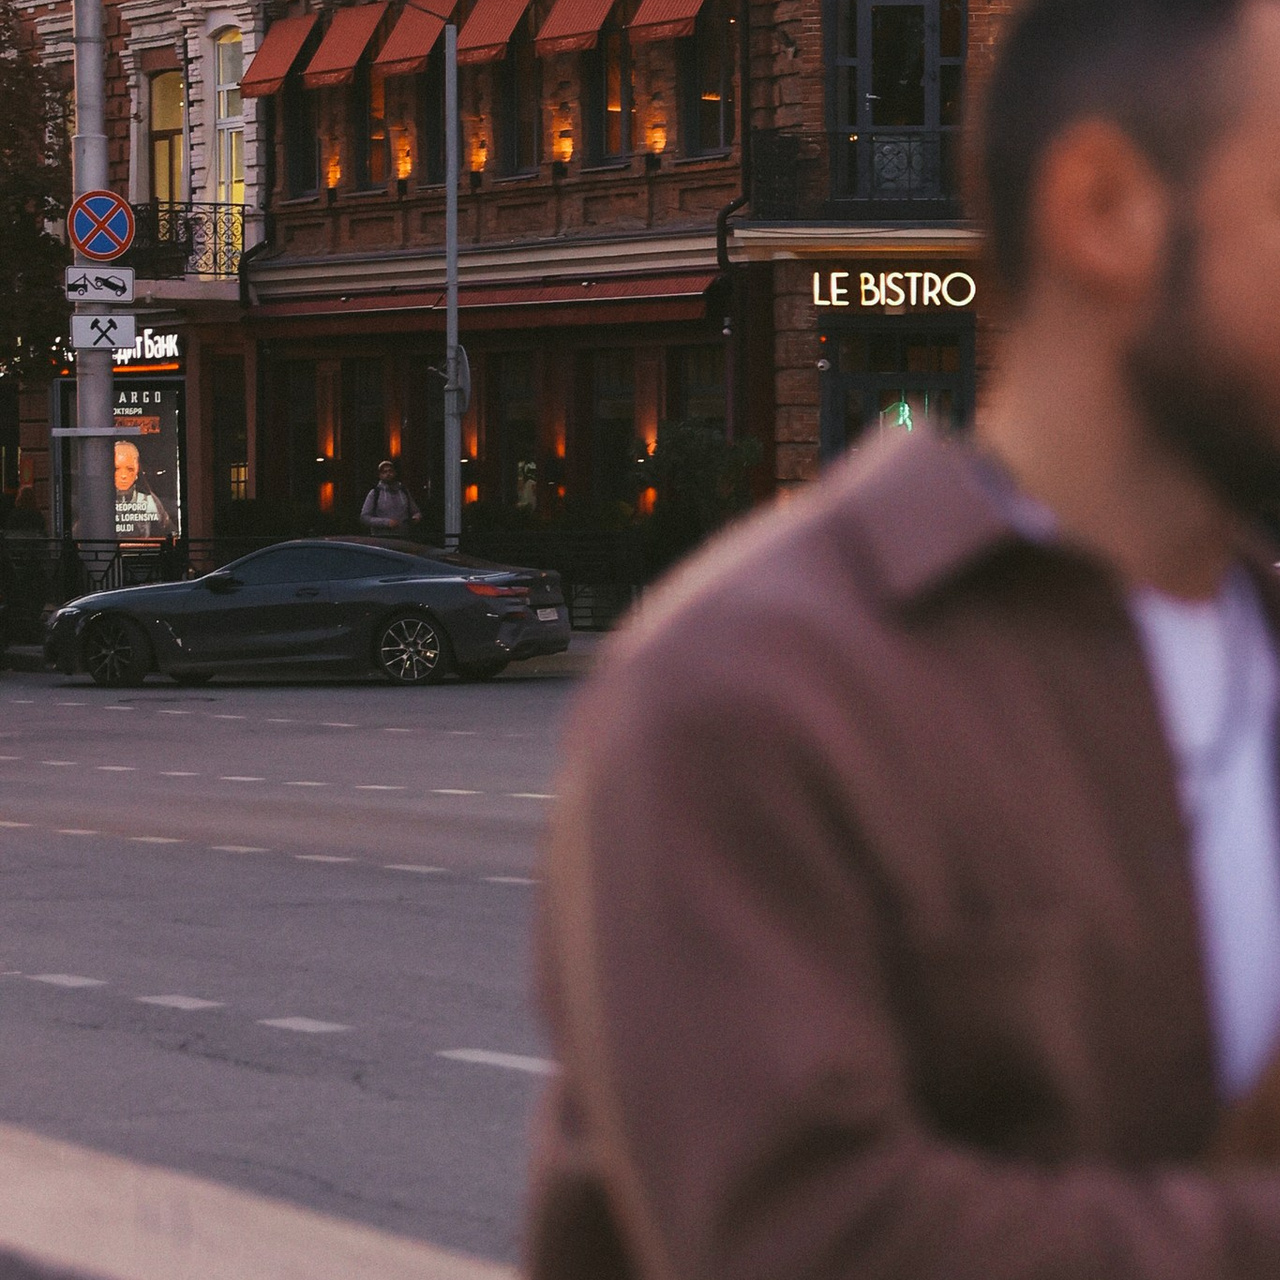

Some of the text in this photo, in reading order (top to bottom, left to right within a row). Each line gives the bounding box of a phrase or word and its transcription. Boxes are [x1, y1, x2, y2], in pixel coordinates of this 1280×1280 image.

[813, 271, 977, 307] LE BISTRO
[144, 328, 179, 359] Банк
